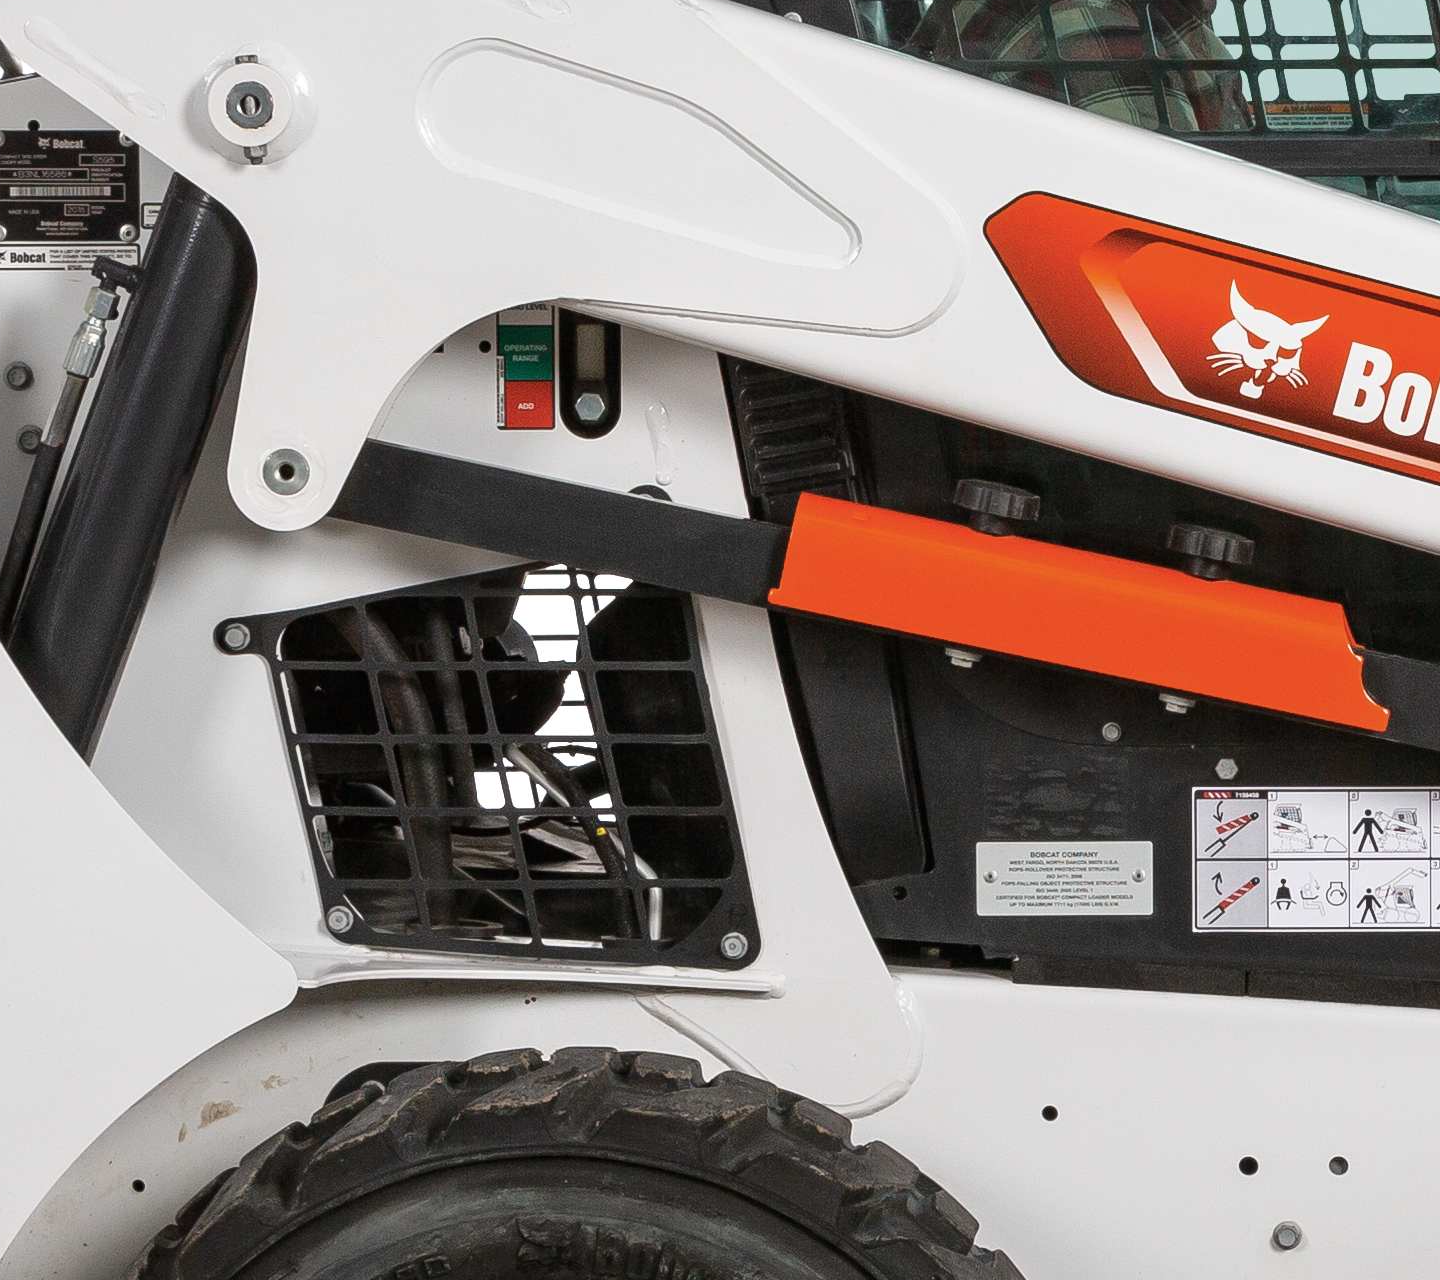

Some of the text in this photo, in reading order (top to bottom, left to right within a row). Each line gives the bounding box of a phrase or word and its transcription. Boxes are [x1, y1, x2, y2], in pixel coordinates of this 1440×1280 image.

[52, 138, 84, 149] Bobcat
[10, 252, 46, 264] Bobcat
[503, 344, 548, 352] OPERATING
[512, 354, 539, 362] RANGE
